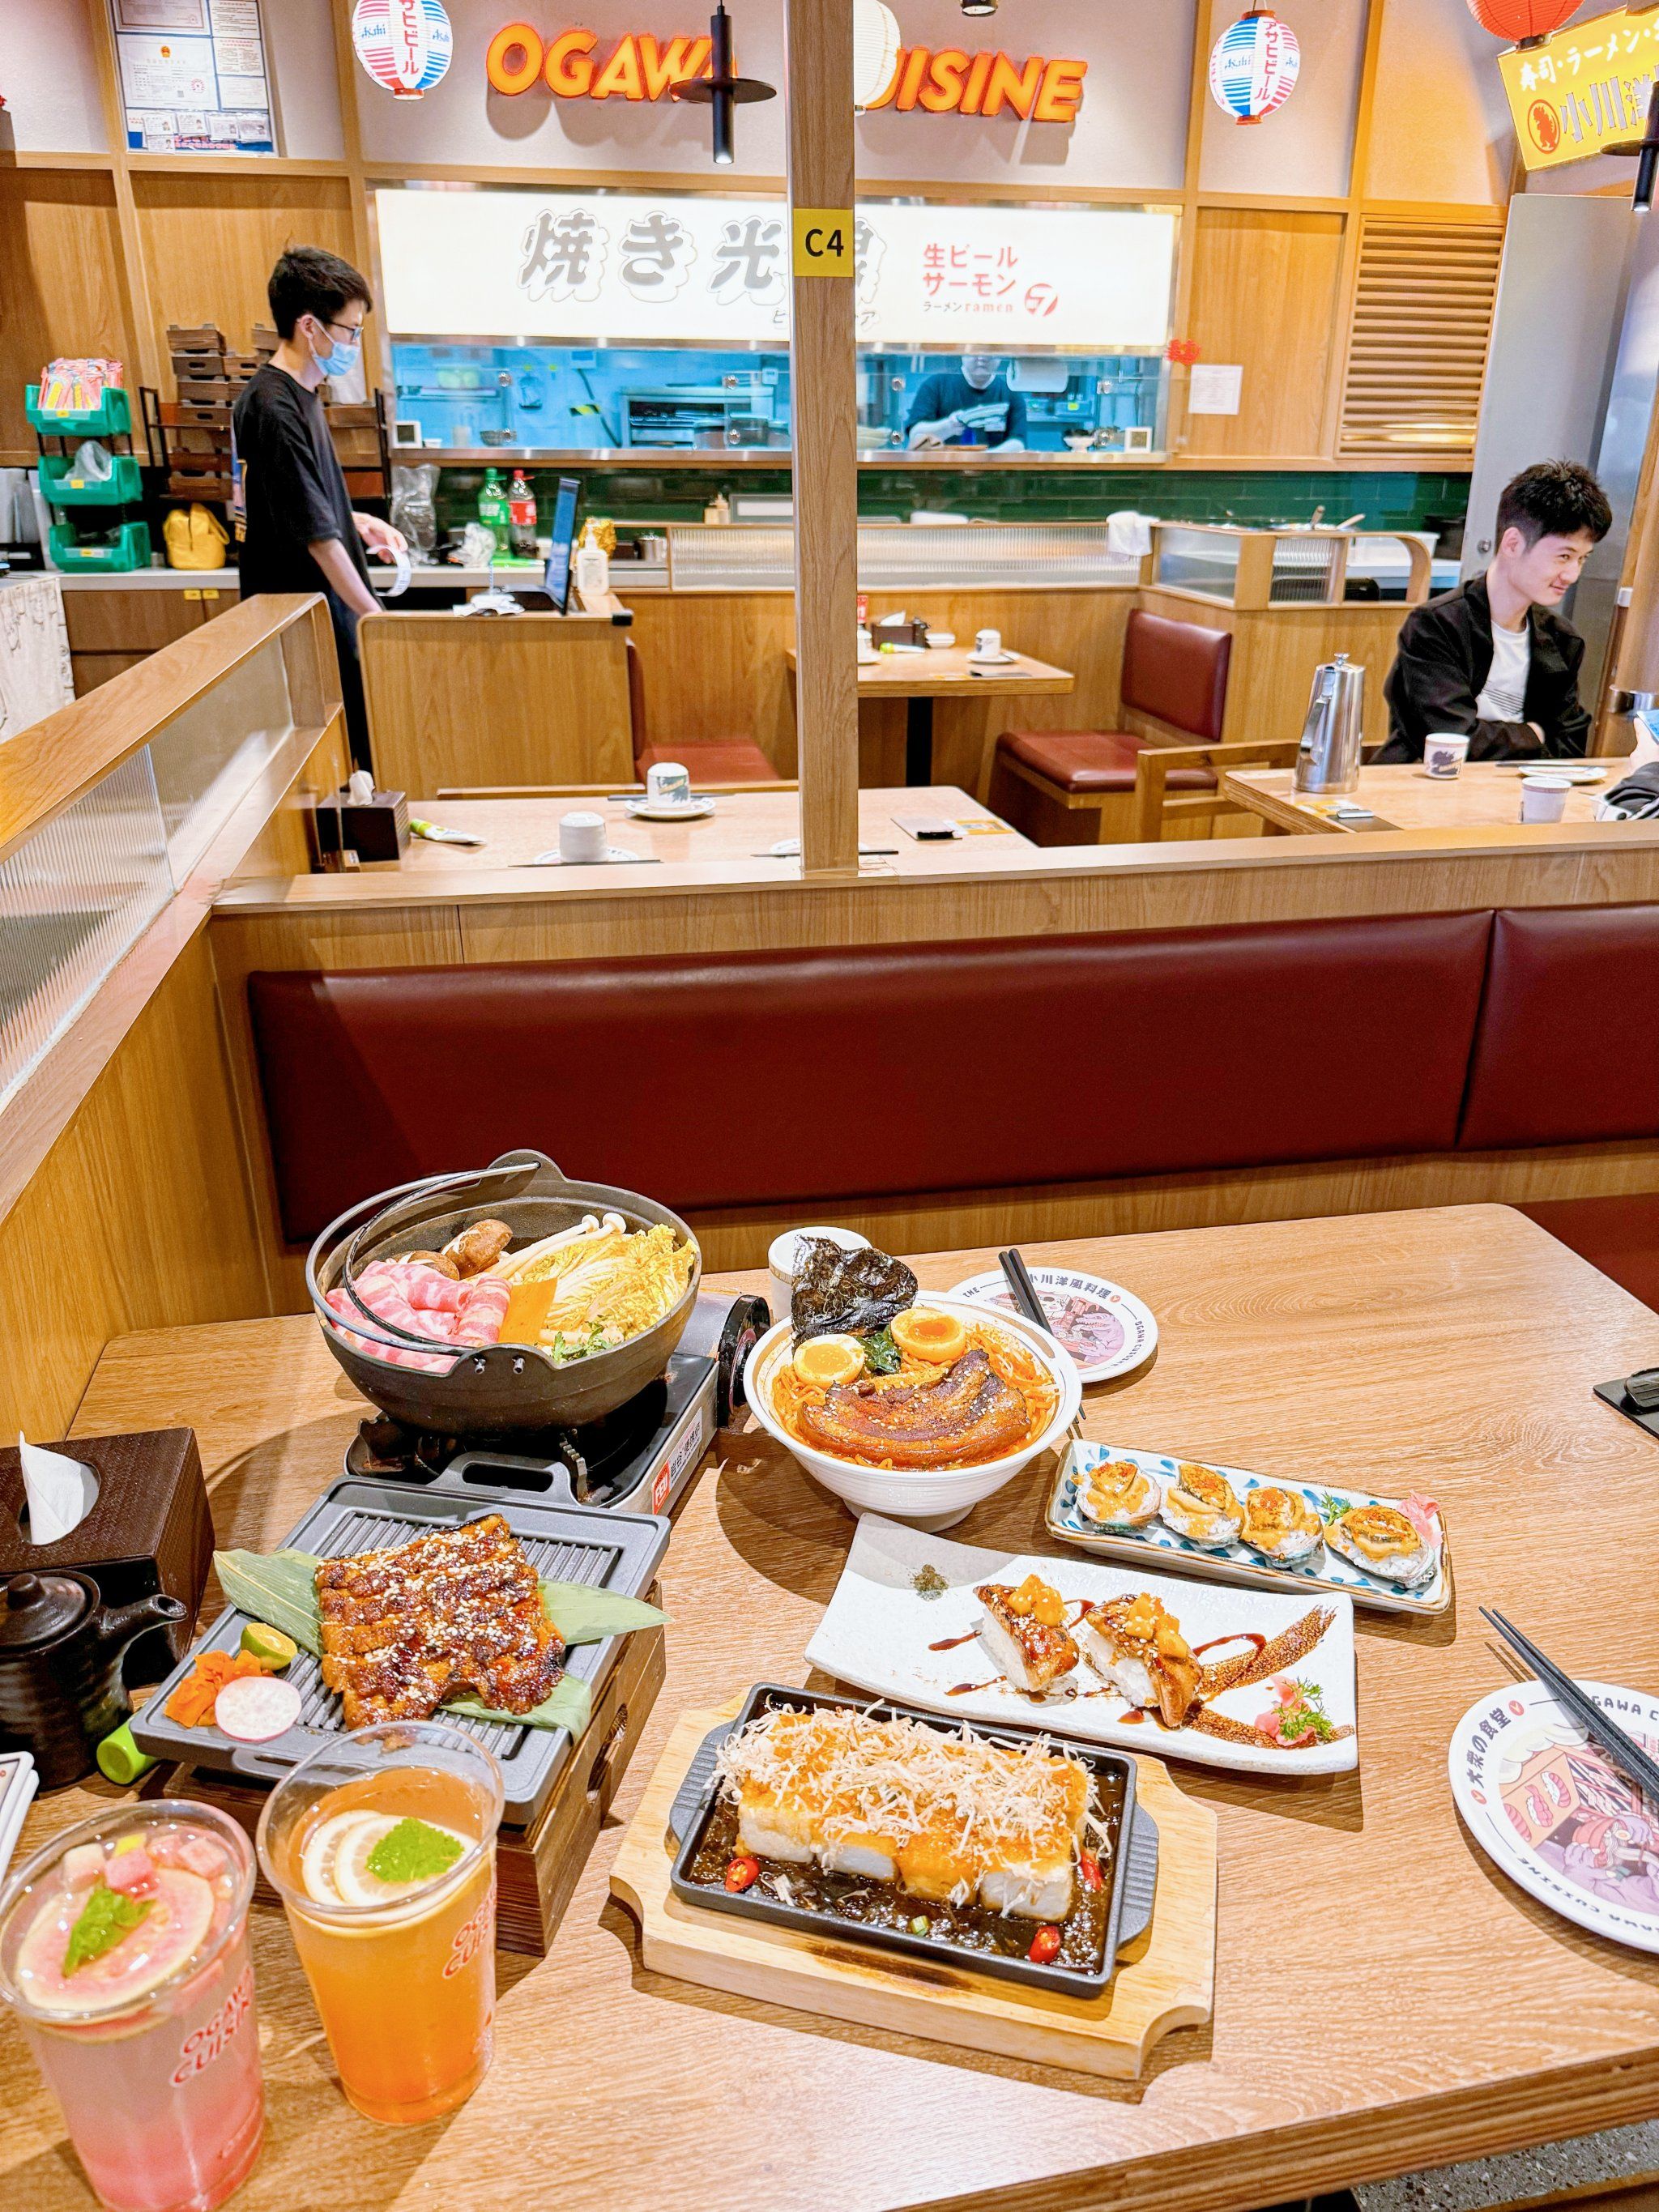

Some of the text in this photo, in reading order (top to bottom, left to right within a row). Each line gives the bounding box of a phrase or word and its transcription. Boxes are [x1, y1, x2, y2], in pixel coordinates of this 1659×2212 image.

[1254, 21, 1278, 100] アサヒビール
[1559, 64, 1659, 143] 小川洋
[804, 228, 844, 258] C4
[923, 244, 1018, 268] 生ビール
[923, 272, 1017, 296] サーモン
[965, 302, 1013, 313] ramen
[1591, 1695, 1642, 1715] GAWA
